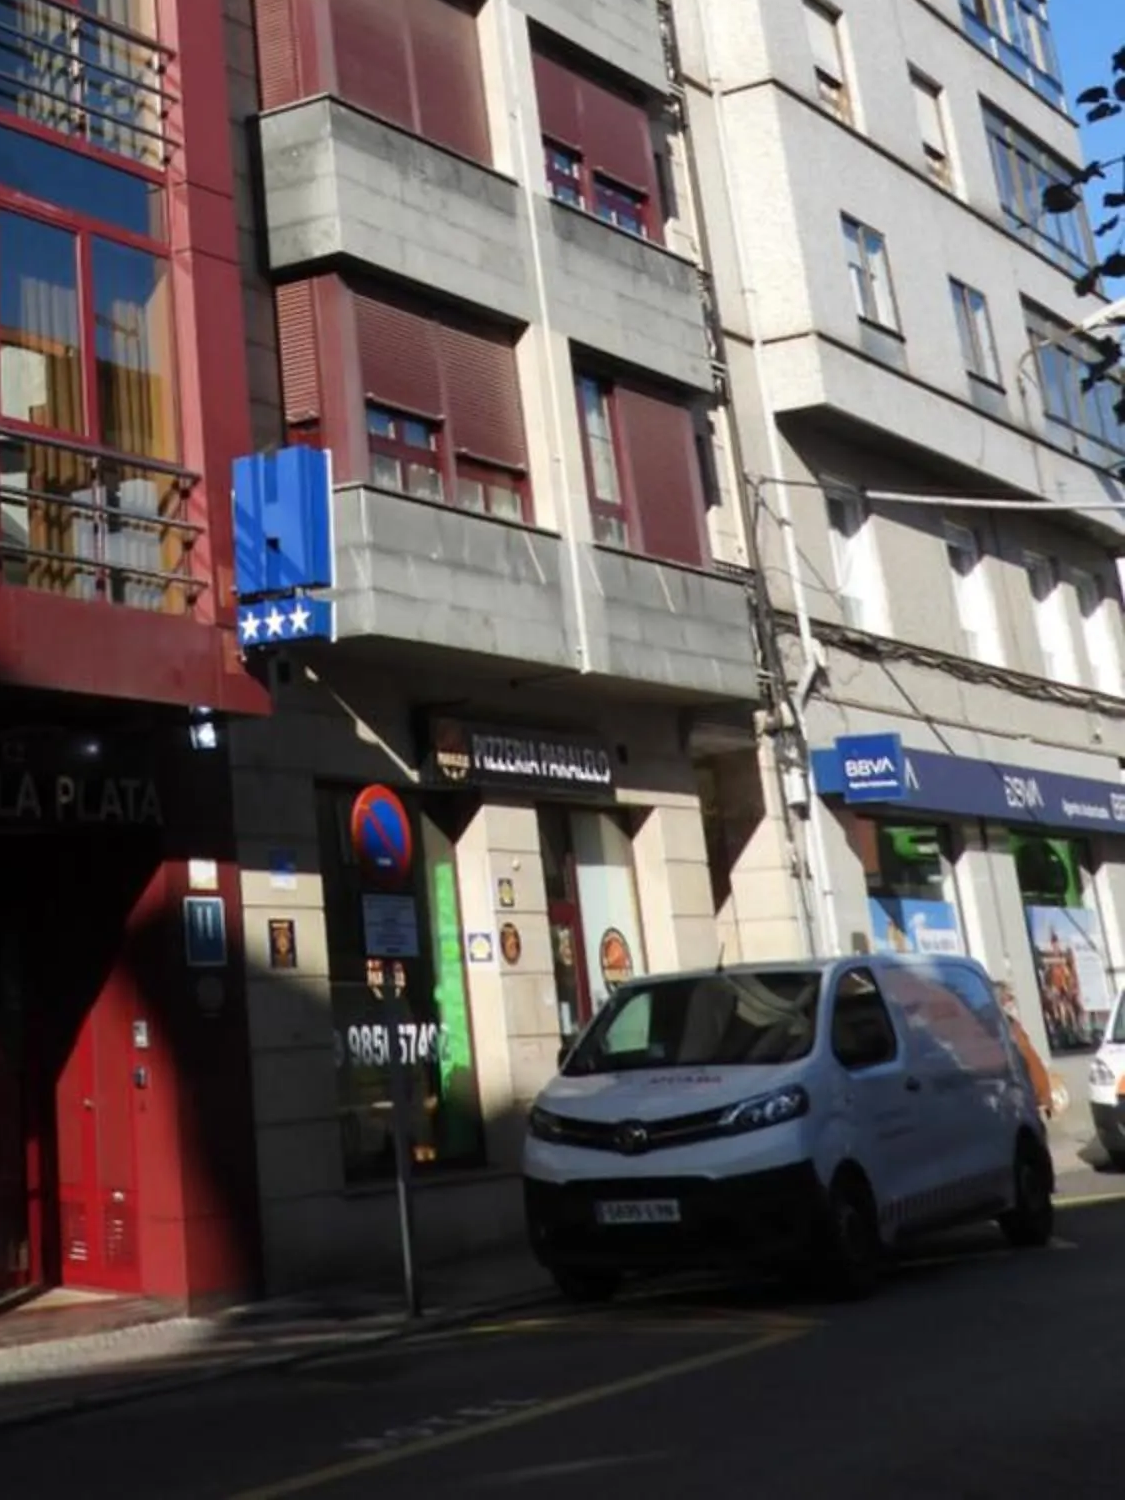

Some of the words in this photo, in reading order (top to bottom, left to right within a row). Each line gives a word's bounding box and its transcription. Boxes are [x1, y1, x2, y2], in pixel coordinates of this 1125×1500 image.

[472, 734, 539, 775] PIZZERIA
[540, 742, 611, 784] PARALELO
[845, 756, 895, 777] BBVA
[56, 774, 166, 826] PLATA
[1003, 774, 1045, 808] BBVA
